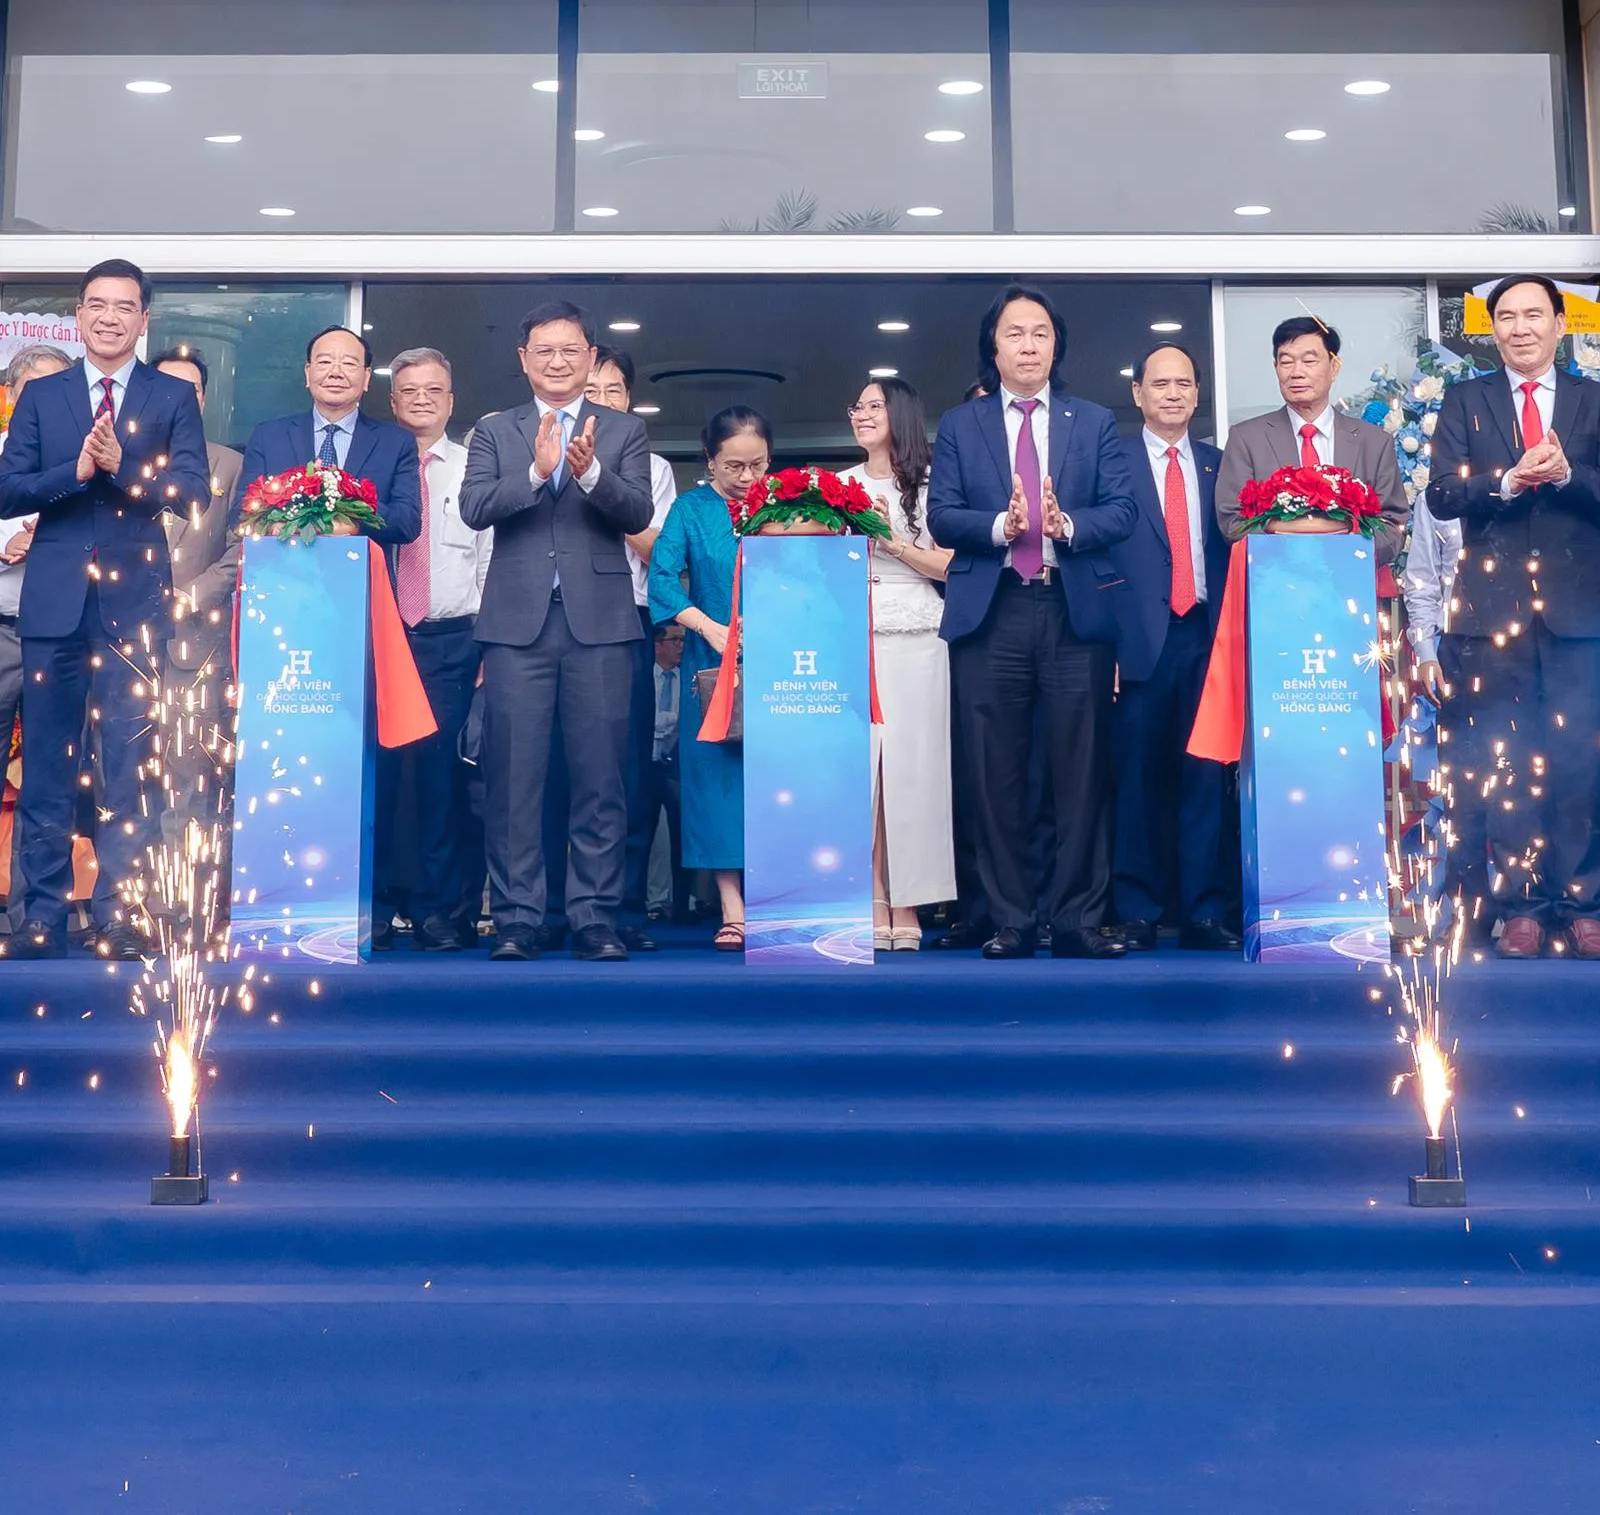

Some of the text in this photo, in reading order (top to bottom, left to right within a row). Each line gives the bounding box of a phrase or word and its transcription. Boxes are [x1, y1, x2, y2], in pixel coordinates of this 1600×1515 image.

[757, 69, 810, 82] EXIT
[13, 320, 19, 336] Y
[22, 321, 49, 342] Dược
[288, 650, 312, 674] H
[793, 651, 817, 675] H
[1302, 649, 1327, 674] H
